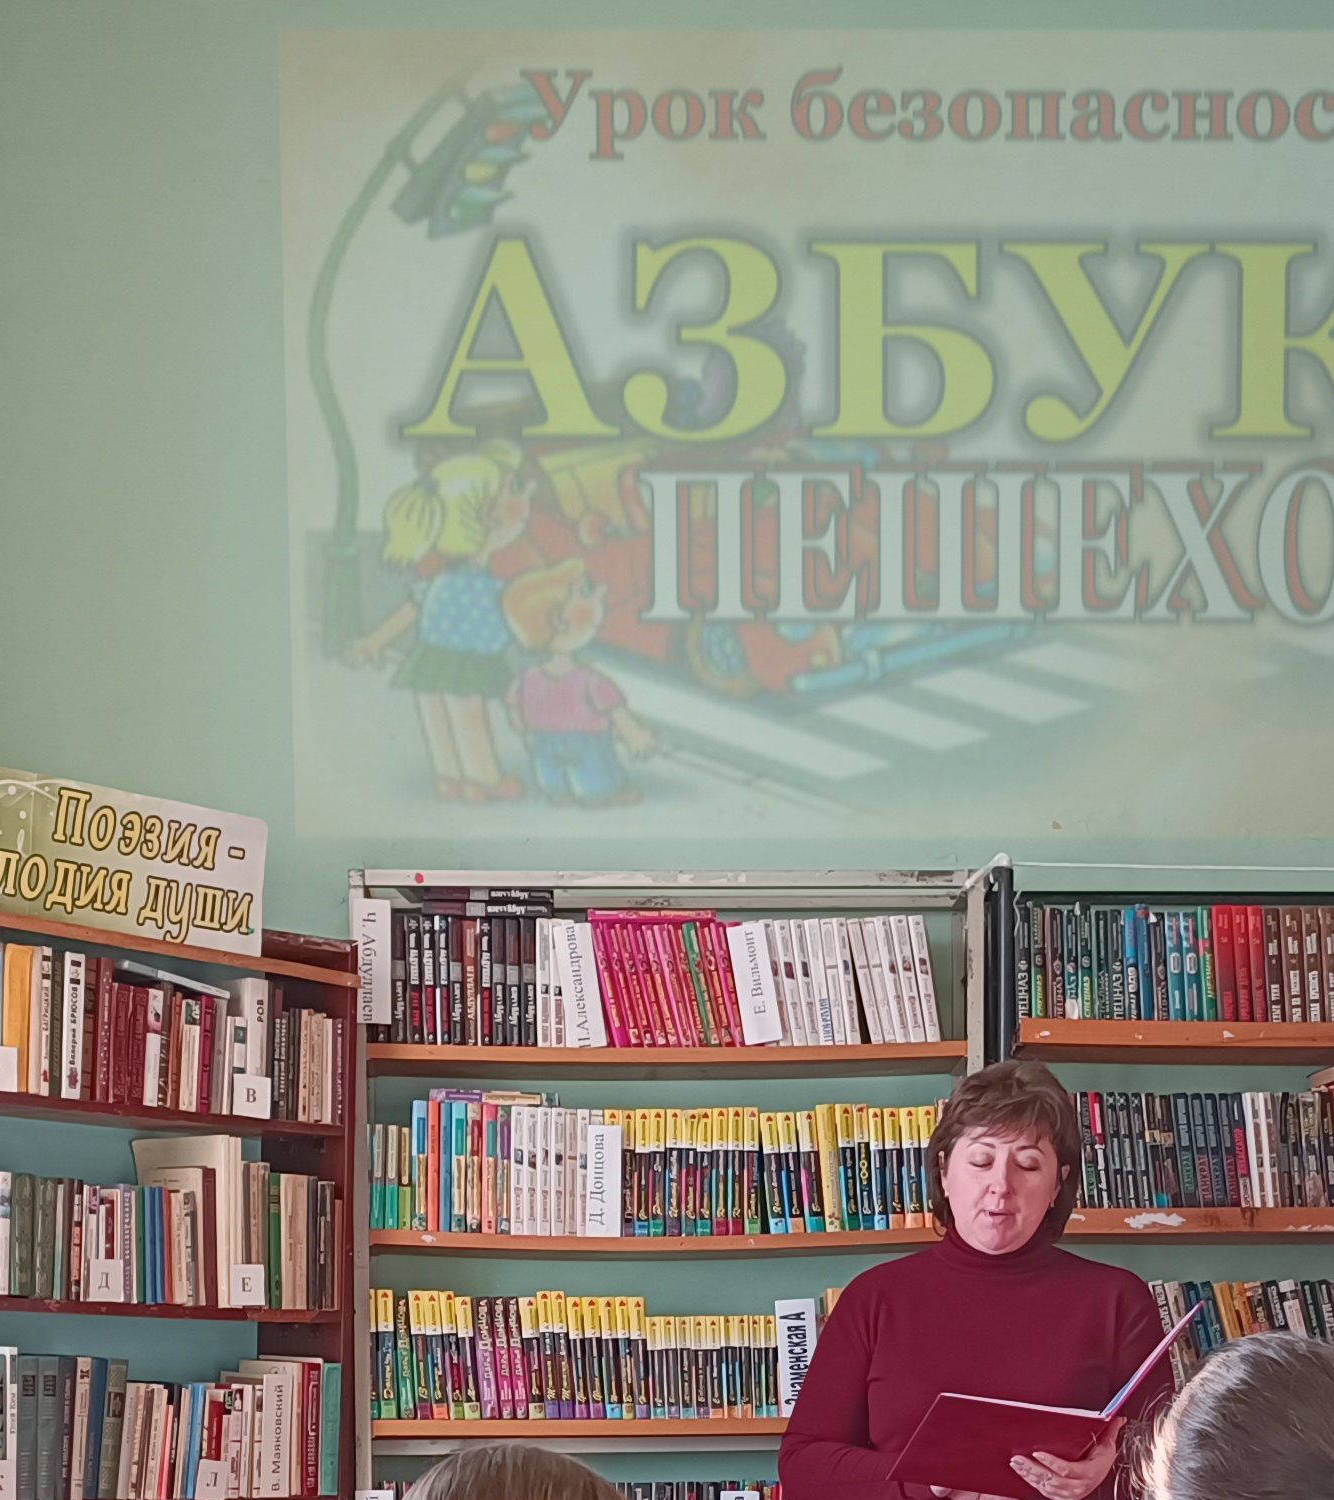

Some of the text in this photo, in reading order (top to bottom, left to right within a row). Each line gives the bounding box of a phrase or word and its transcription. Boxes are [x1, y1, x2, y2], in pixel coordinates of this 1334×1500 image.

[520, 67, 769, 160] Урок
[52, 786, 222, 871] Поэзия
[137, 875, 255, 944] души
[361, 933, 378, 1023] Абдуллаев
[744, 929, 765, 1000] Вильмонт
[70, 985, 80, 1028] БРЮСОВ
[246, 1087, 257, 1103] В
[588, 1133, 605, 1226] Д. Донцова
[98, 1272, 111, 1291] Д
[241, 1277, 252, 1293] Е
[779, 1311, 806, 1321] А
[271, 1383, 285, 1492] В. Маяковский
[206, 1472, 219, 1488] Л
